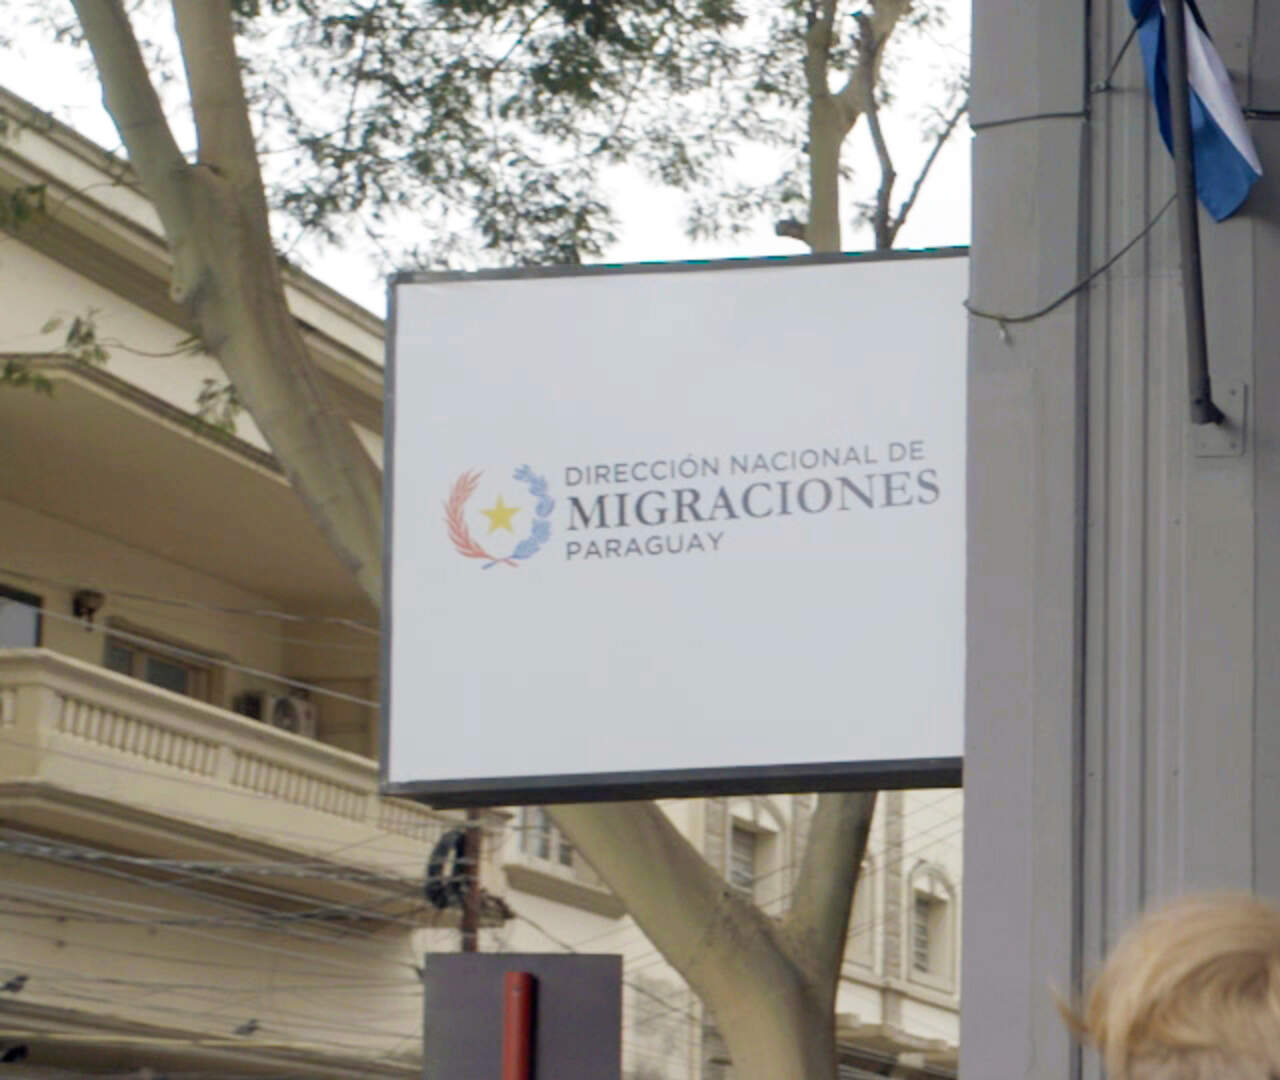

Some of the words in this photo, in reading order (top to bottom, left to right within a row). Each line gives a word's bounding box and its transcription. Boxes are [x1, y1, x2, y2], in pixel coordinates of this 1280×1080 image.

[565, 453, 719, 487] DIRECCIÓN
[730, 445, 878, 475] NACIONAL
[888, 440, 925, 462] DE
[566, 468, 942, 532] MIGRACIONES
[565, 531, 725, 561] PARAGUAY
